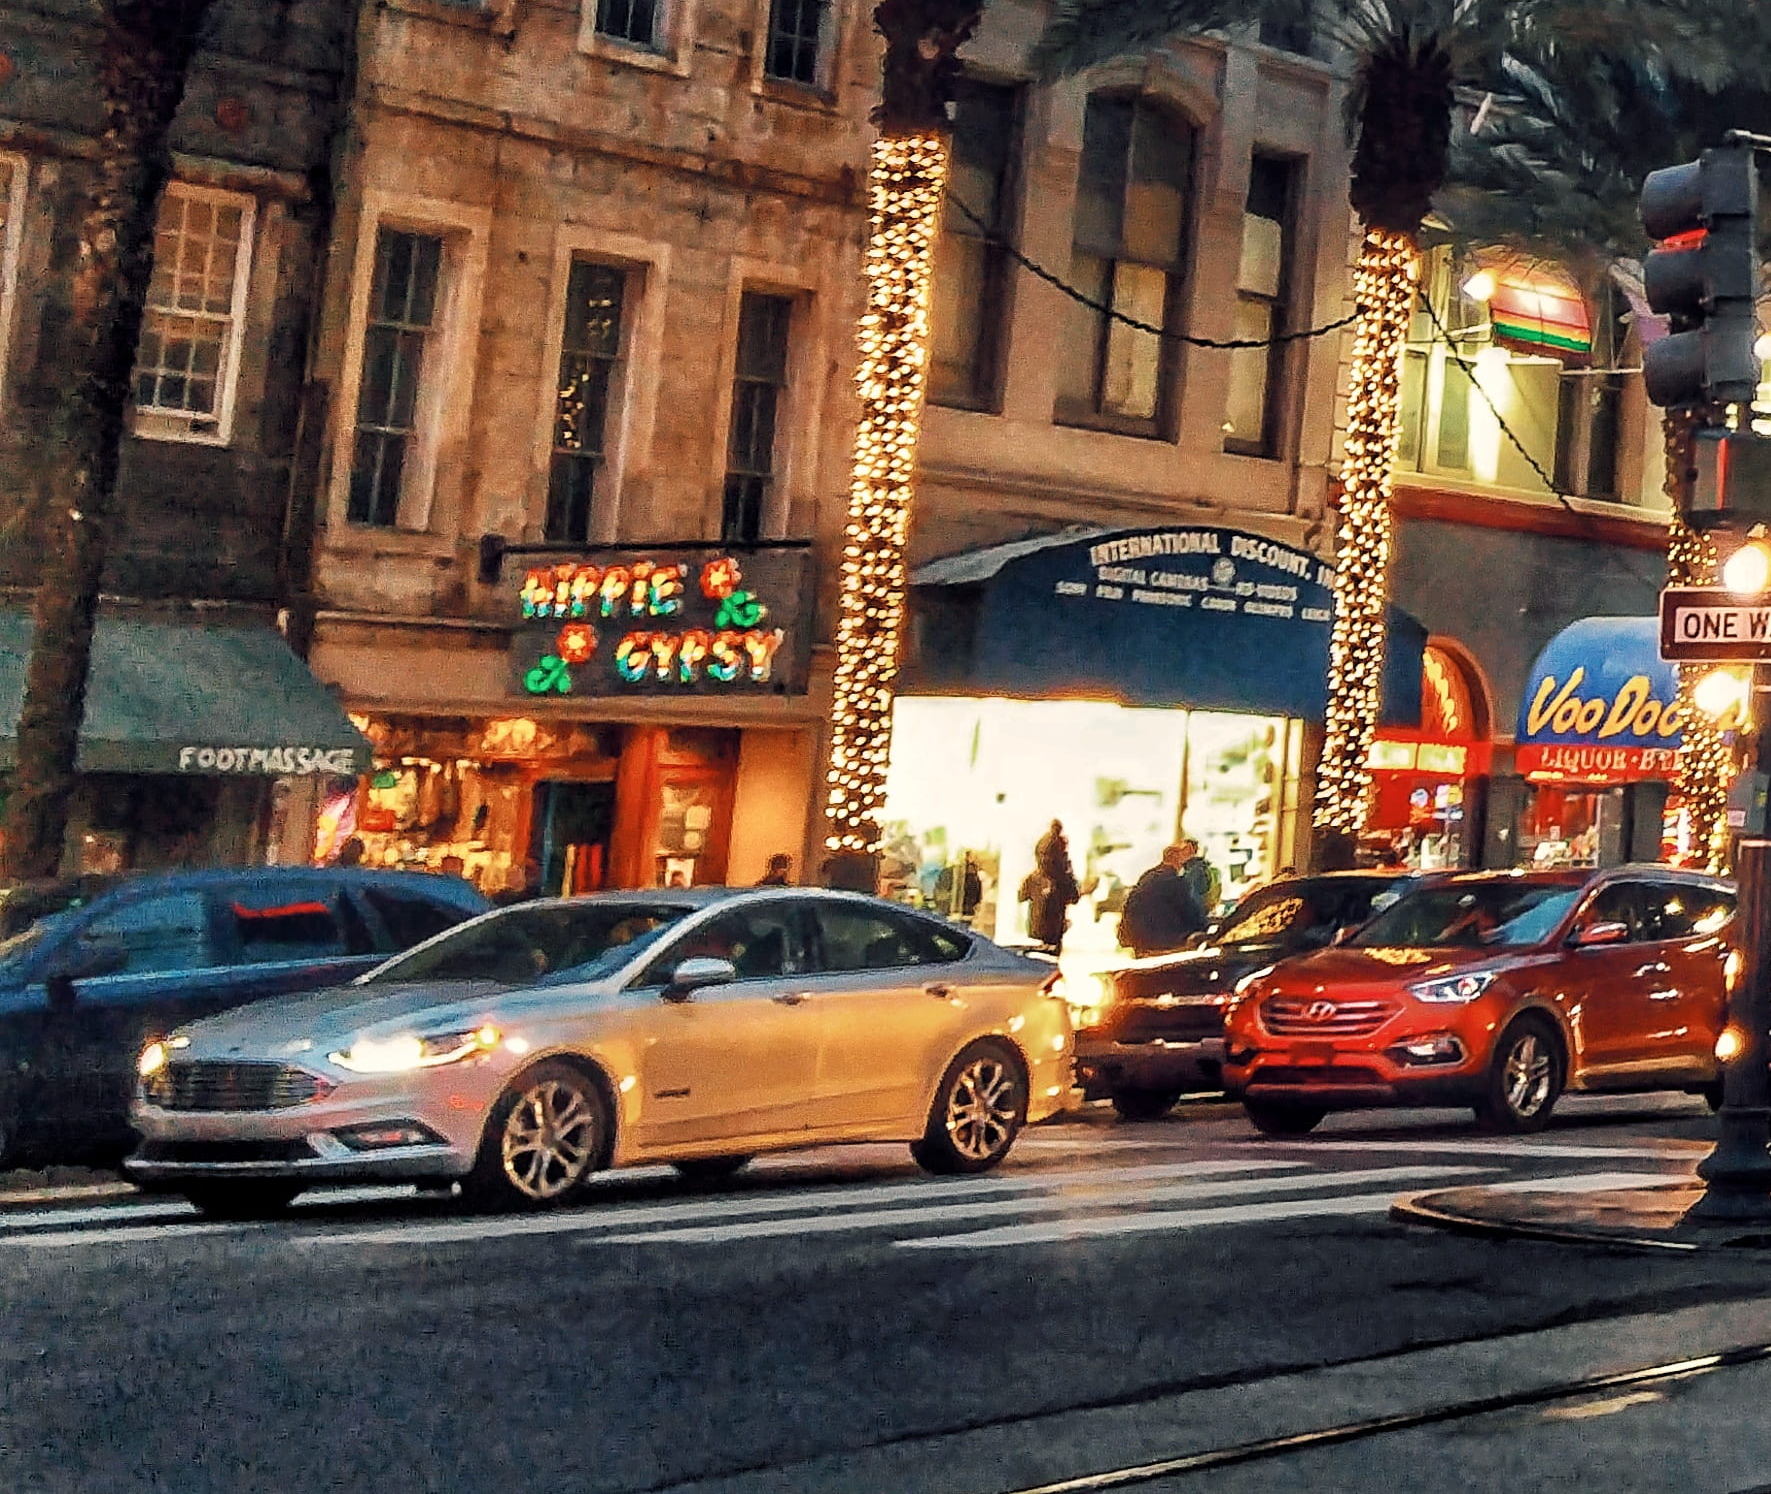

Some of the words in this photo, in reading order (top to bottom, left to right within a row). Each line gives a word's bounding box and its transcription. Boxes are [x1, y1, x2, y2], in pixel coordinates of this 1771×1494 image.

[1090, 531, 1221, 567] INTERNATIONAL
[520, 561, 688, 619] HIPPIE
[1684, 612, 1739, 640] ONE
[616, 627, 785, 683] GYPSY
[1541, 746, 1627, 773] LIQUOR
